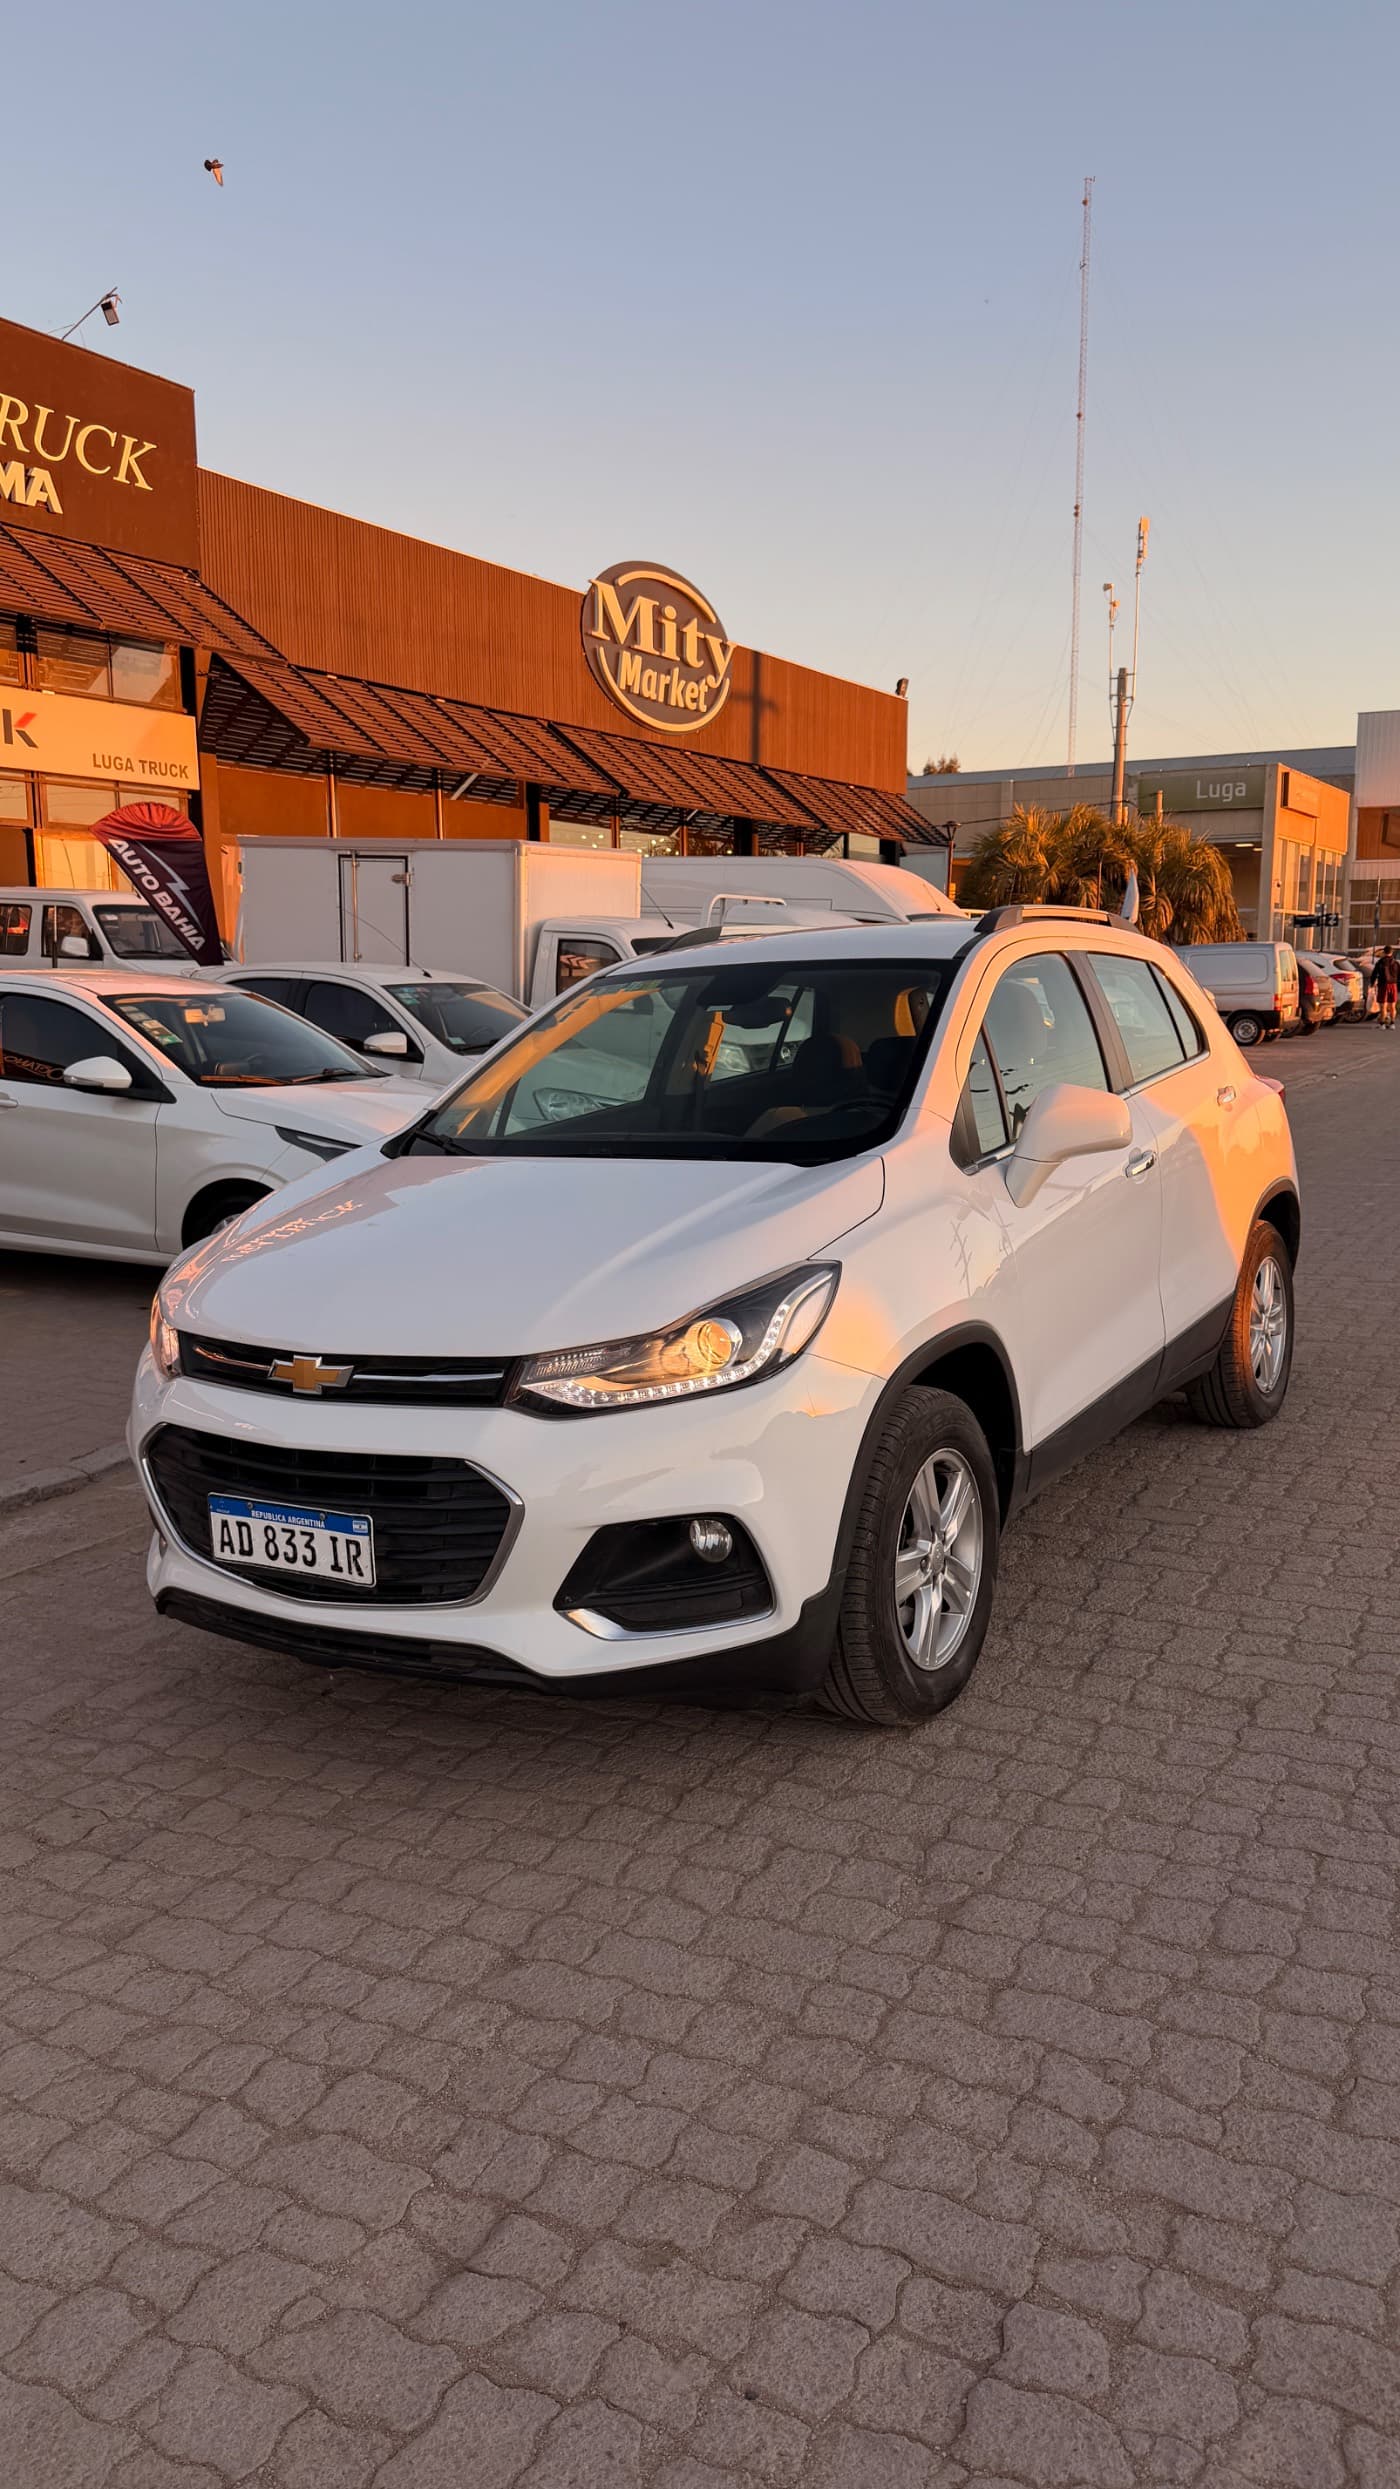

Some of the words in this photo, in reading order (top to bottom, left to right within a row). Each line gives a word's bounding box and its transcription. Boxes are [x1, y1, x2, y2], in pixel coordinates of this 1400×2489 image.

[0, 393, 157, 491] RUCK
[587, 579, 738, 688] Mity
[618, 650, 708, 712] Market
[2, 708, 39, 748] K
[92, 753, 135, 772] LUGA
[138, 759, 189, 779] TRUCK
[1196, 780, 1247, 802] Luga
[108, 838, 160, 891] AUTO
[152, 891, 206, 950] BAHIA
[220, 1519, 254, 1557] AD
[263, 1525, 317, 1568] 833
[329, 1535, 364, 1577] IR
[251, 1510, 286, 1523] REPUBLICA
[287, 1515, 326, 1529] ARGENTINA
